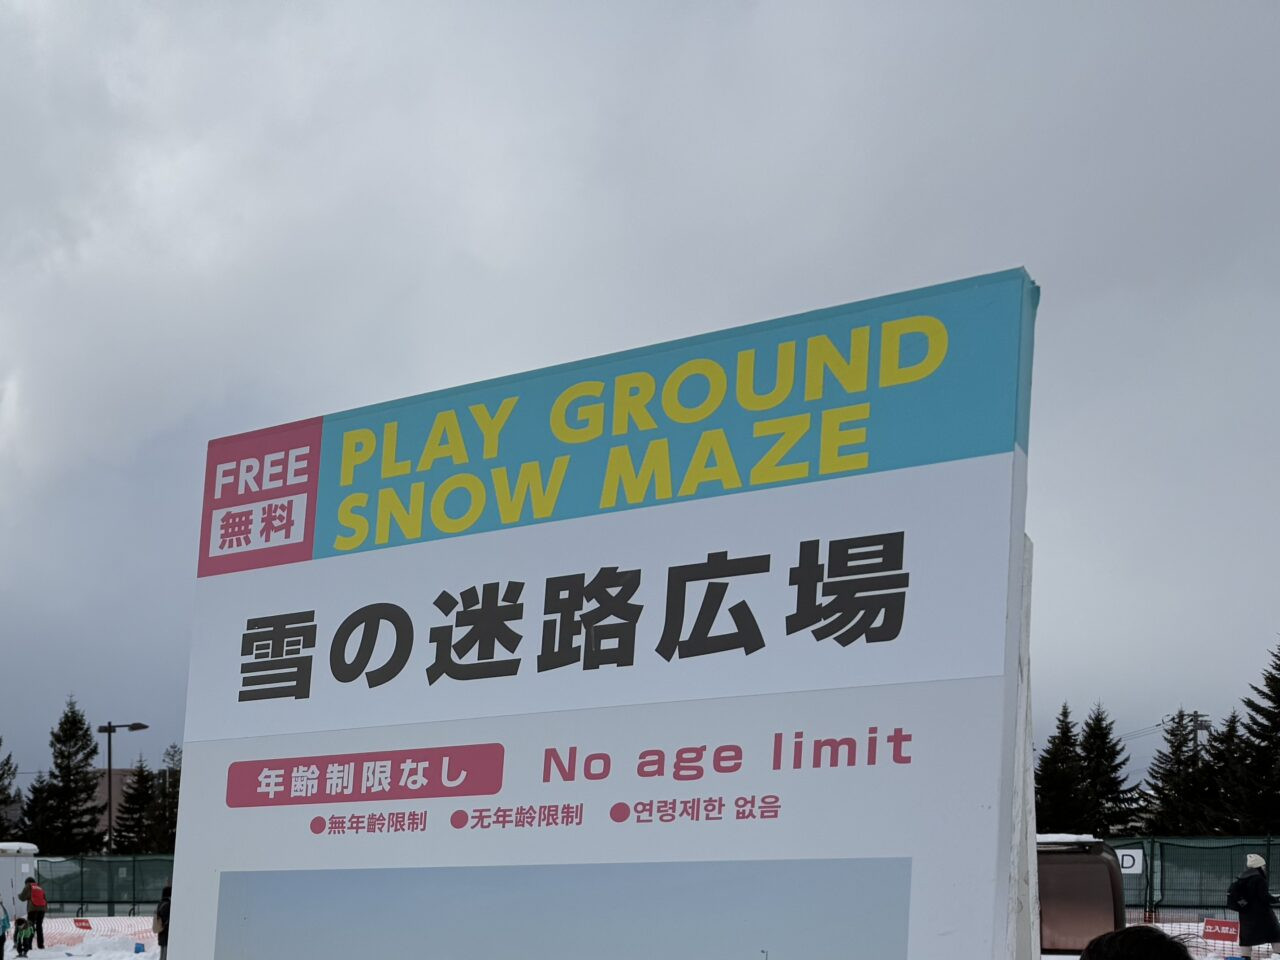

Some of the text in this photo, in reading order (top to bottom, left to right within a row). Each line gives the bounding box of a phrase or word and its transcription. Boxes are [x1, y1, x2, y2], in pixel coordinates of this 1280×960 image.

[339, 314, 948, 487] PLAY GROUND
[213, 446, 310, 500] FREE
[333, 404, 871, 550] SNOW MAZE
[218, 500, 295, 551] 無料
[237, 531, 910, 703] 雪の迷路広場
[255, 754, 469, 800] 年齢制限なし
[543, 727, 913, 784] No age limit
[633, 795, 782, 824] 연령제한 없음
[1121, 854, 1135, 869] D
